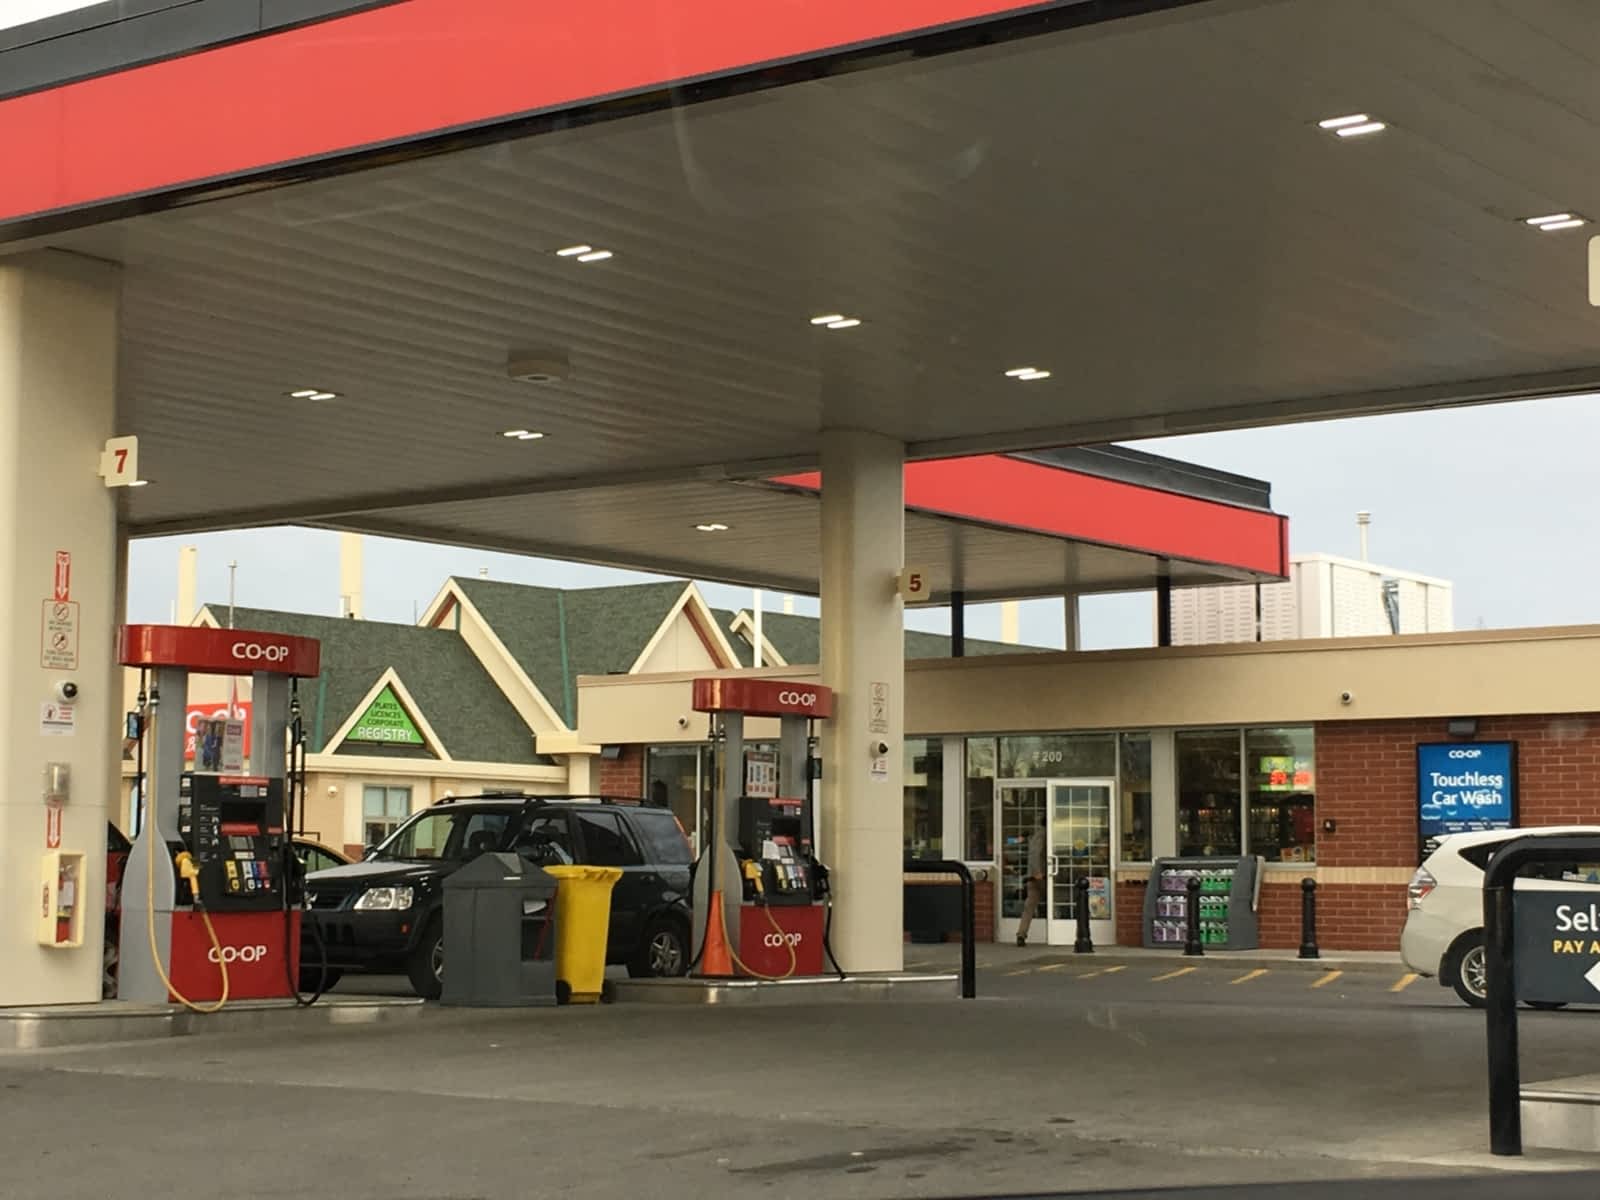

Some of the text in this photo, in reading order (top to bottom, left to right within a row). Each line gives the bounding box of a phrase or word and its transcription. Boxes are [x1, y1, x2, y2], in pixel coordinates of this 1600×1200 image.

[114, 448, 128, 474] 7
[909, 574, 922, 592] 5
[232, 642, 289, 662] CO-OP
[778, 690, 817, 707] CO-OP
[358, 726, 412, 741] REGISTRY
[1448, 750, 1482, 759] CO-OP
[1430, 771, 1503, 787] Touchless
[1432, 790, 1502, 805] Car Wash
[1556, 903, 1600, 932] Sel
[764, 933, 802, 947] COOP
[1553, 940, 1585, 953] PAY
[207, 944, 267, 963] CO-OP
